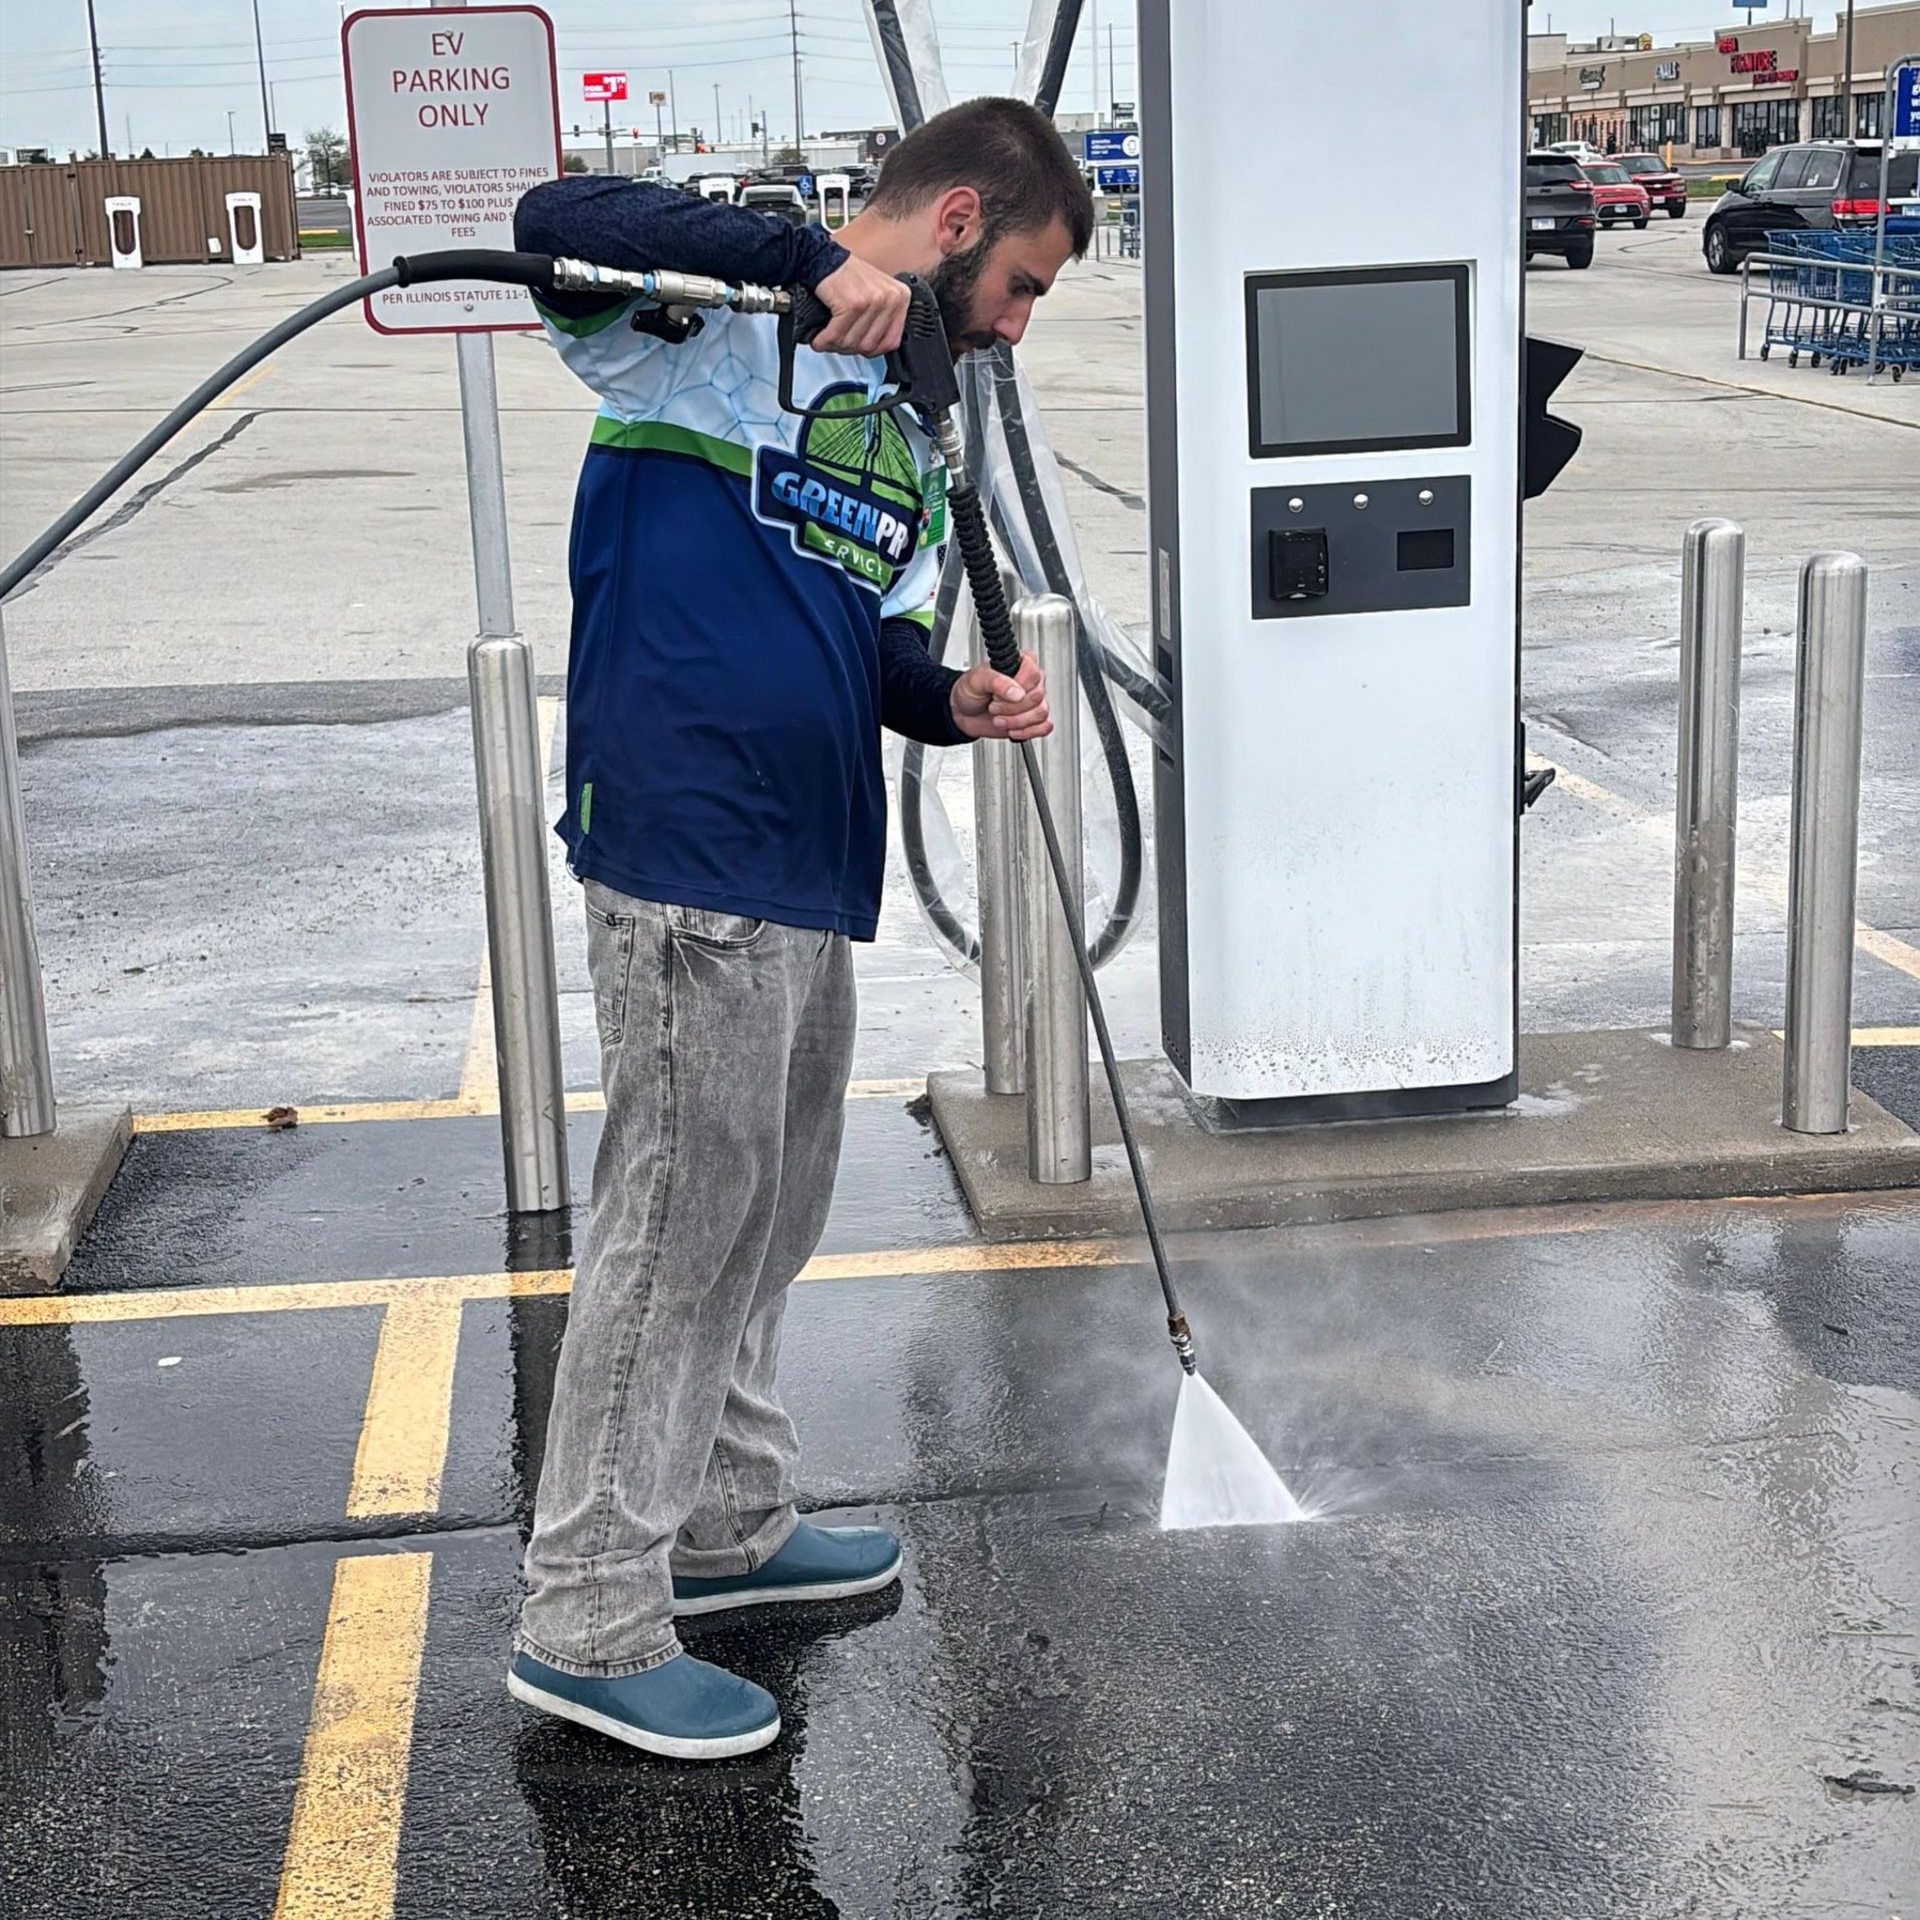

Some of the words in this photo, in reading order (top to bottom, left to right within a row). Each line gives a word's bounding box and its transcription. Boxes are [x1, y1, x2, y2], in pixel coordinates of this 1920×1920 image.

[432, 32, 464, 56] EV
[392, 67, 511, 93] PARKING
[418, 103, 489, 128] ONLY
[369, 171, 429, 183] VIOLATORS
[431, 171, 452, 181] ARE
[454, 169, 499, 181] SUBJECT
[501, 168, 517, 178] TO
[519, 167, 549, 178] FINES
[366, 186, 390, 197] AND
[393, 185, 442, 197] TOWING,
[443, 183, 504, 194] VIOLATORS
[384, 201, 416, 212] FINED
[418, 200, 438, 211] $75
[442, 199, 456, 210] TO
[458, 198, 485, 209] $100
[487, 197, 514, 208] PLUS
[367, 215, 433, 226] ASSOCIATED
[435, 213, 481, 225] TOWING
[483, 212, 507, 222] AND
[451, 227, 476, 237] FEES
[383, 293, 403, 304] PER
[406, 291, 451, 304] ILLINOIS
[453, 290, 503, 302] STATUTE
[506, 289, 529, 300] 11-1
[771, 471, 909, 560] GREENPR
